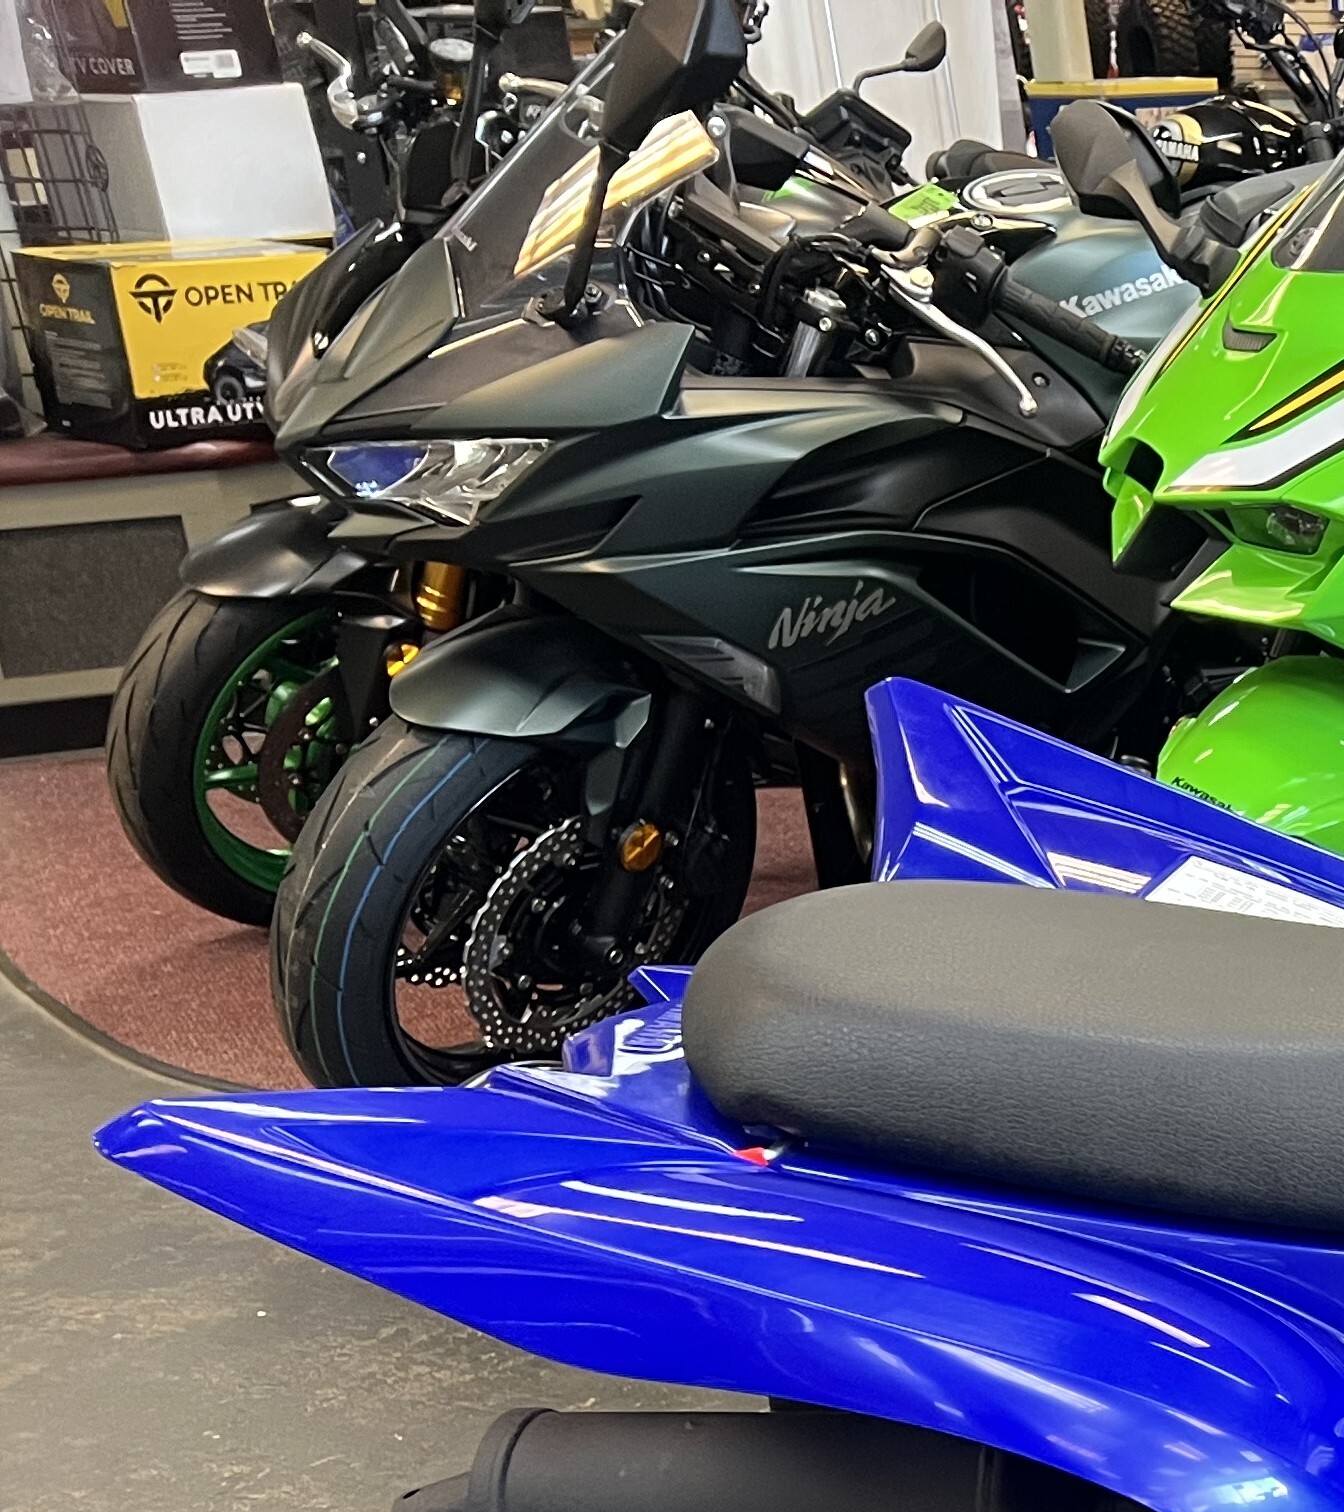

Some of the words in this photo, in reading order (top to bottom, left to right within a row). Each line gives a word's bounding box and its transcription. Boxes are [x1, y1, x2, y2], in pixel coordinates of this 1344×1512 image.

[88, 57, 136, 76] COVER
[184, 281, 252, 307] OPEN
[1059, 262, 1189, 318] Kawasak
[149, 405, 223, 430] ULTRA
[767, 582, 897, 652] Ninja
